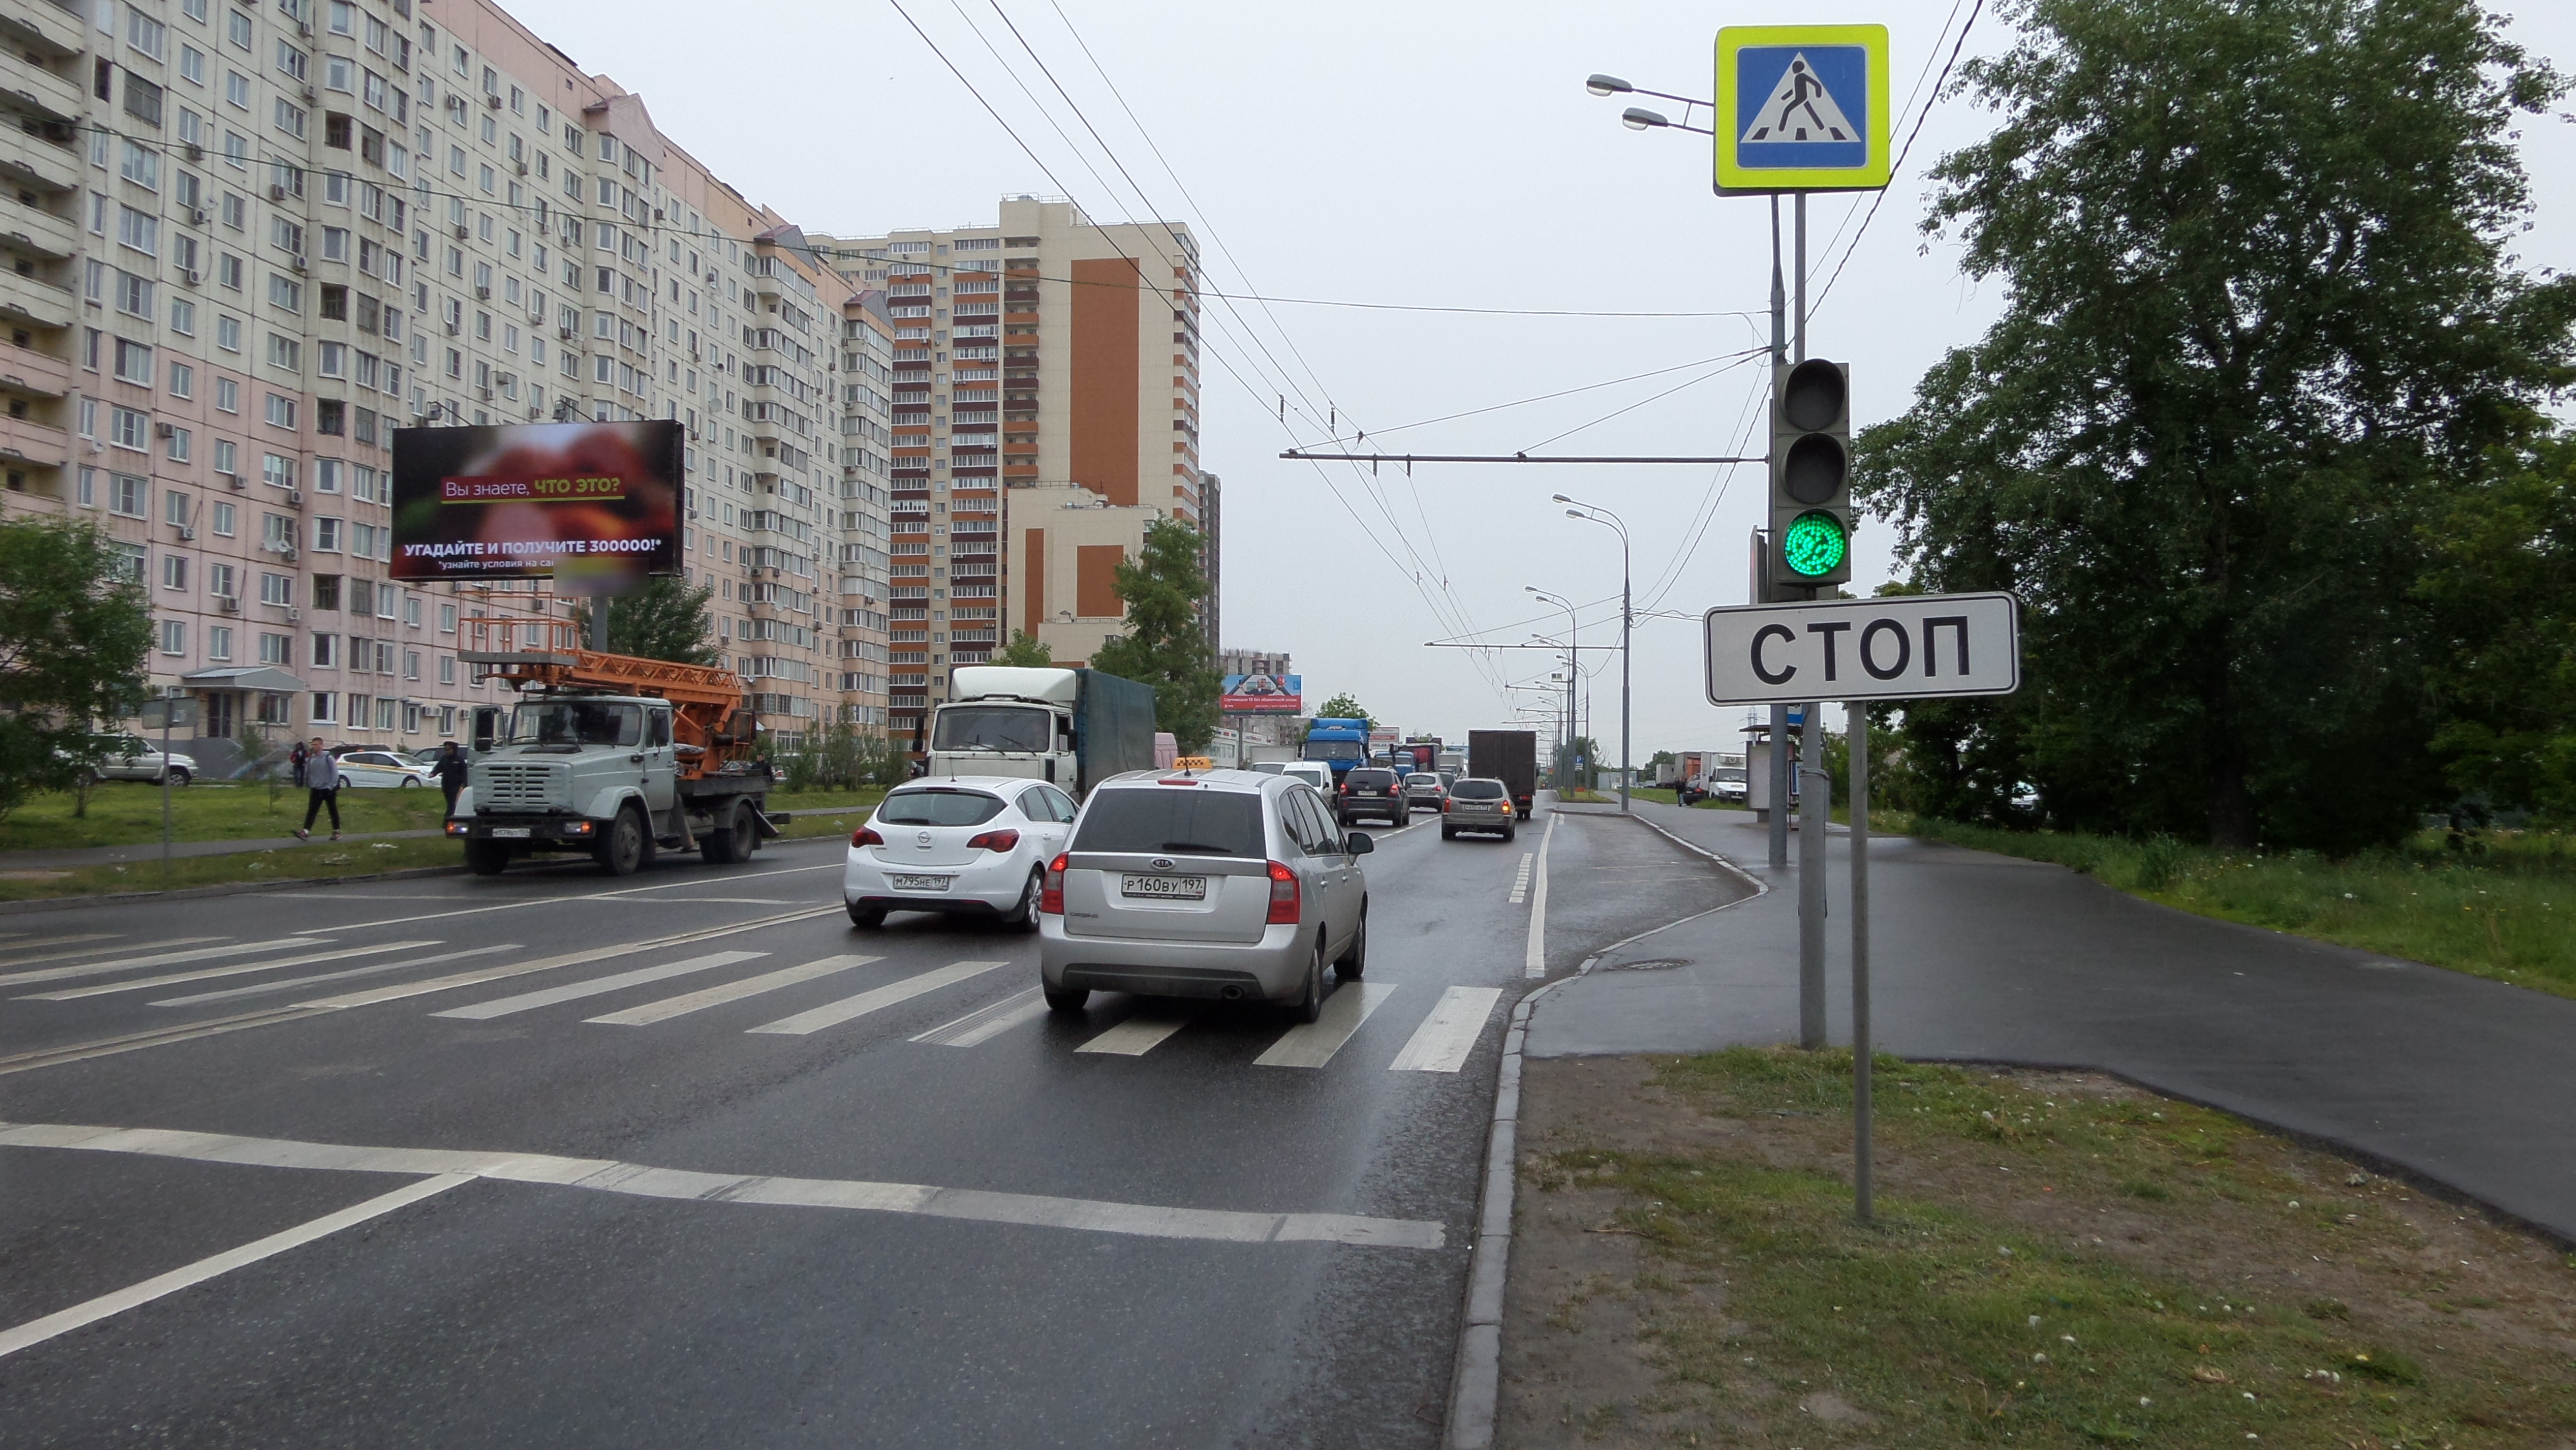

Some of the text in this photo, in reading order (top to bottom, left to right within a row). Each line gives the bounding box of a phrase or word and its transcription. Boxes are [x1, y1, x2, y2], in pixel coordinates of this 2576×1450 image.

[446, 478, 620, 496] Вы знаете, ЧТО ЭТО?
[405, 540, 484, 558] УГАДАЙТЕ
[488, 543, 499, 554] И
[502, 538, 586, 554] ПОЛУЧИТЕ
[482, 560, 522, 570] условия
[1750, 615, 1970, 686] СТОП
[1126, 878, 1202, 893] Р160ВУ 197
